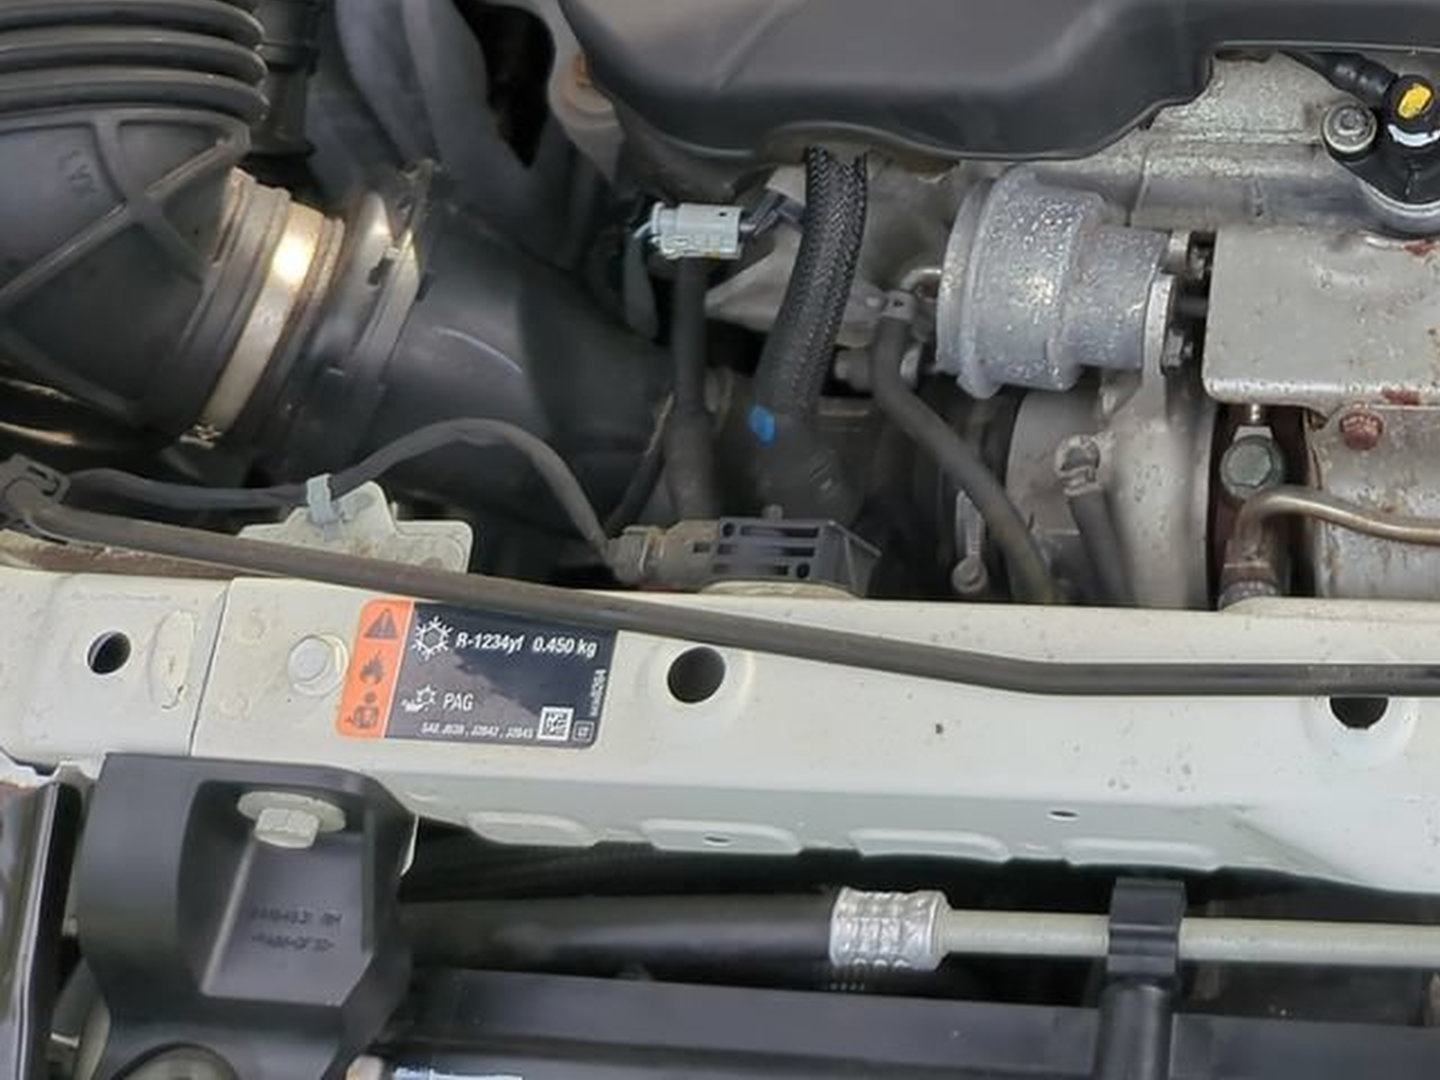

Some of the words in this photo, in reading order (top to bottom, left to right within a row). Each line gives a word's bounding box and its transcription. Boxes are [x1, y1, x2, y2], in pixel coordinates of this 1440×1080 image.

[455, 630, 525, 656] R-1234yf
[532, 636, 575, 654] 0.450
[577, 637, 598, 659] kg
[442, 692, 475, 712] PAG
